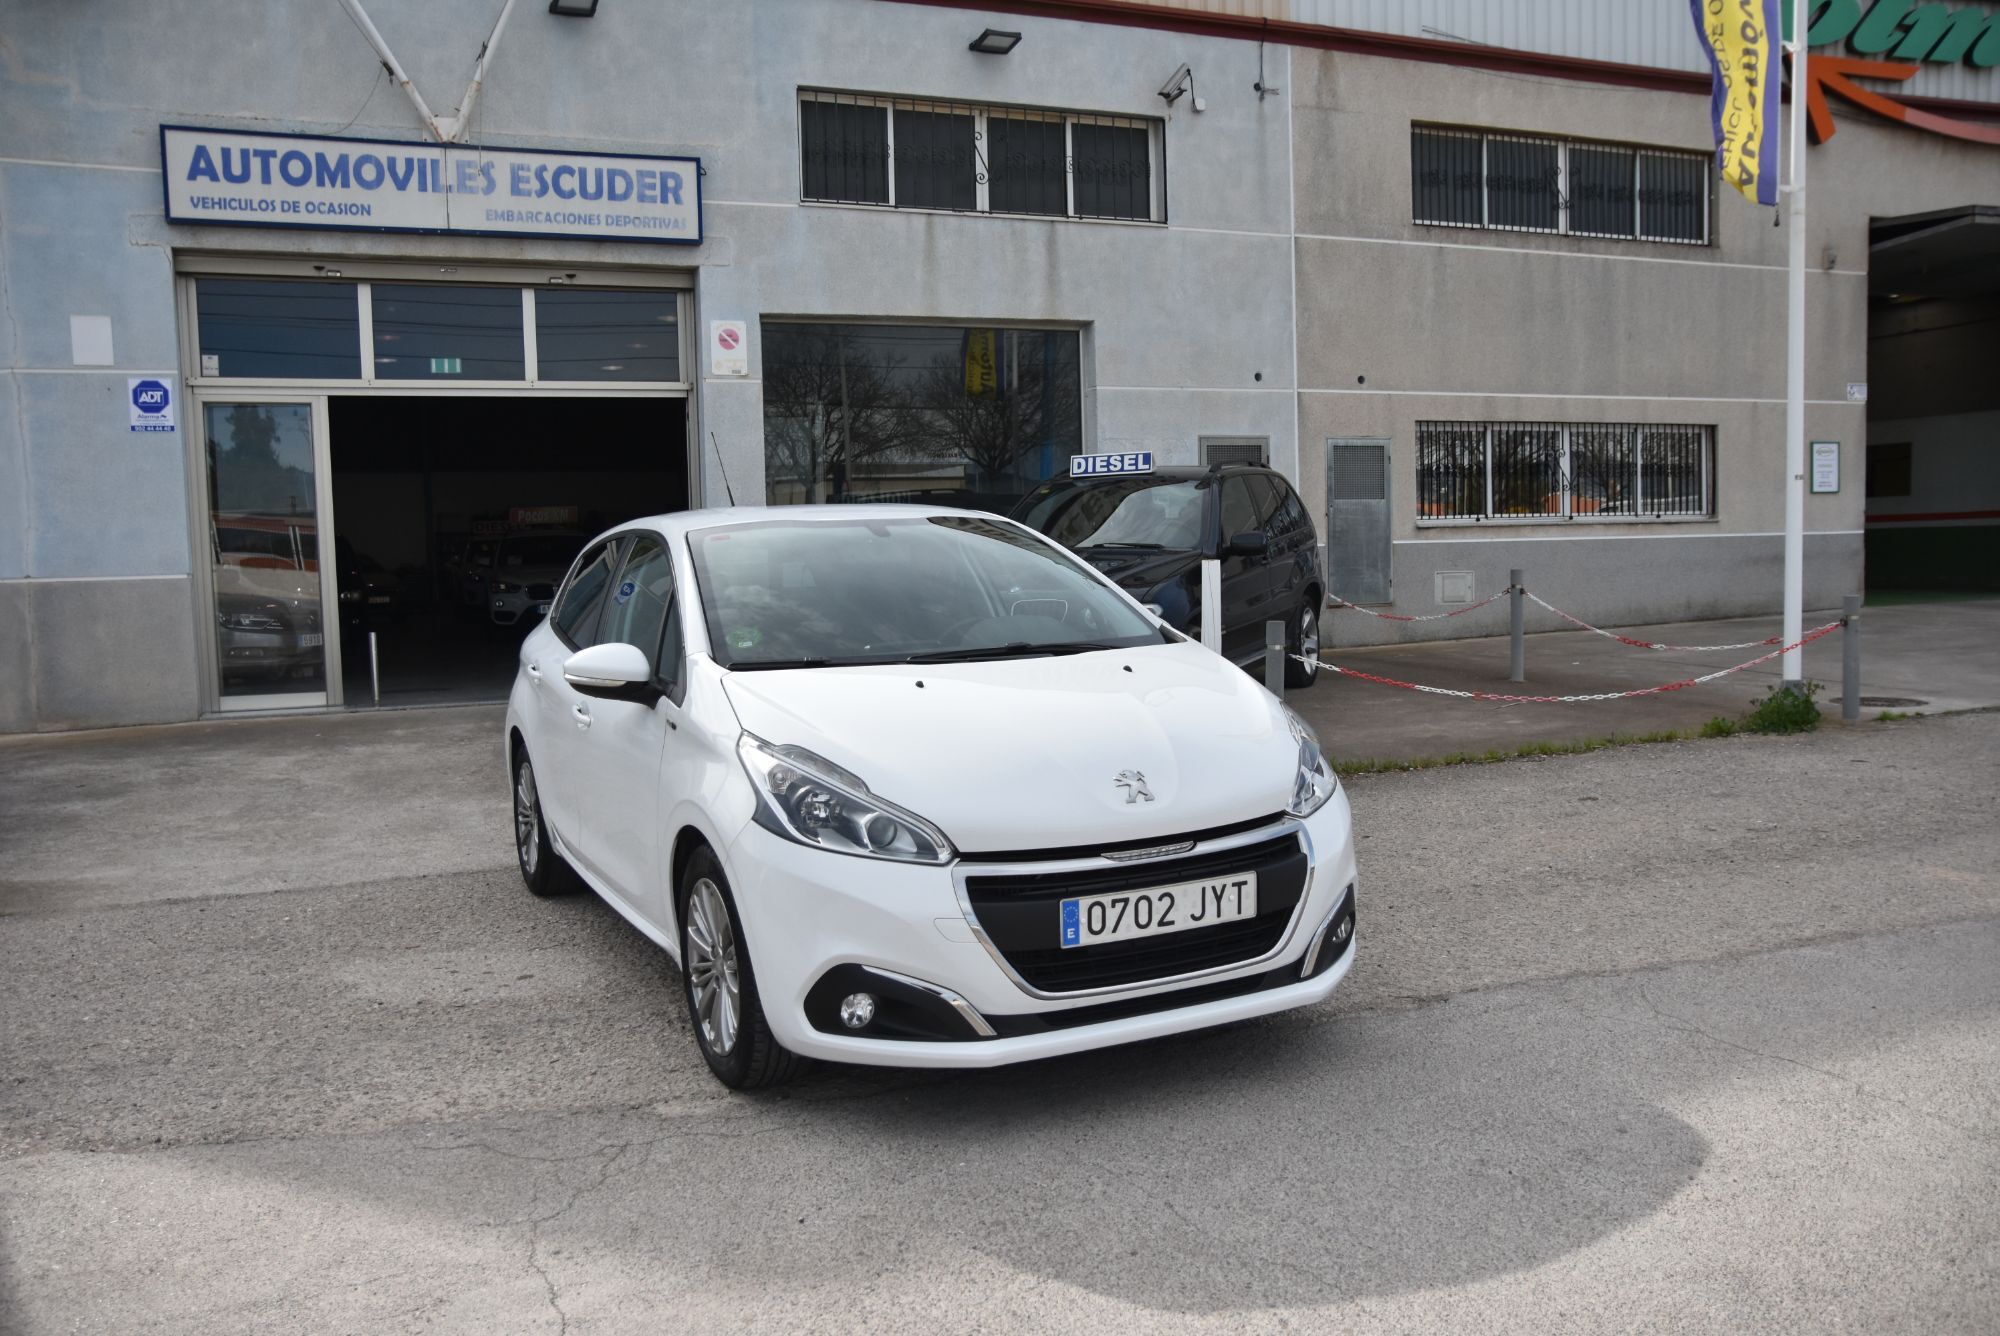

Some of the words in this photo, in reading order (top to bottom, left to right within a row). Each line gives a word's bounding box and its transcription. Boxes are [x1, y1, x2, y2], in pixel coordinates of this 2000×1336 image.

[187, 144, 497, 196] AUTOMOVILES
[510, 161, 684, 205] ESCUDER
[190, 195, 276, 213] VEHICULOS
[281, 201, 300, 213] DE
[305, 201, 372, 216] OCASION
[485, 208, 601, 226] EMBARCACIONES
[605, 214, 687, 231] DEPORTIVAS
[139, 391, 163, 403] ADT
[1073, 453, 1150, 474] DIESEL
[1087, 892, 1176, 936] 0702
[1190, 880, 1248, 922] JYT
[1067, 928, 1075, 939] E
